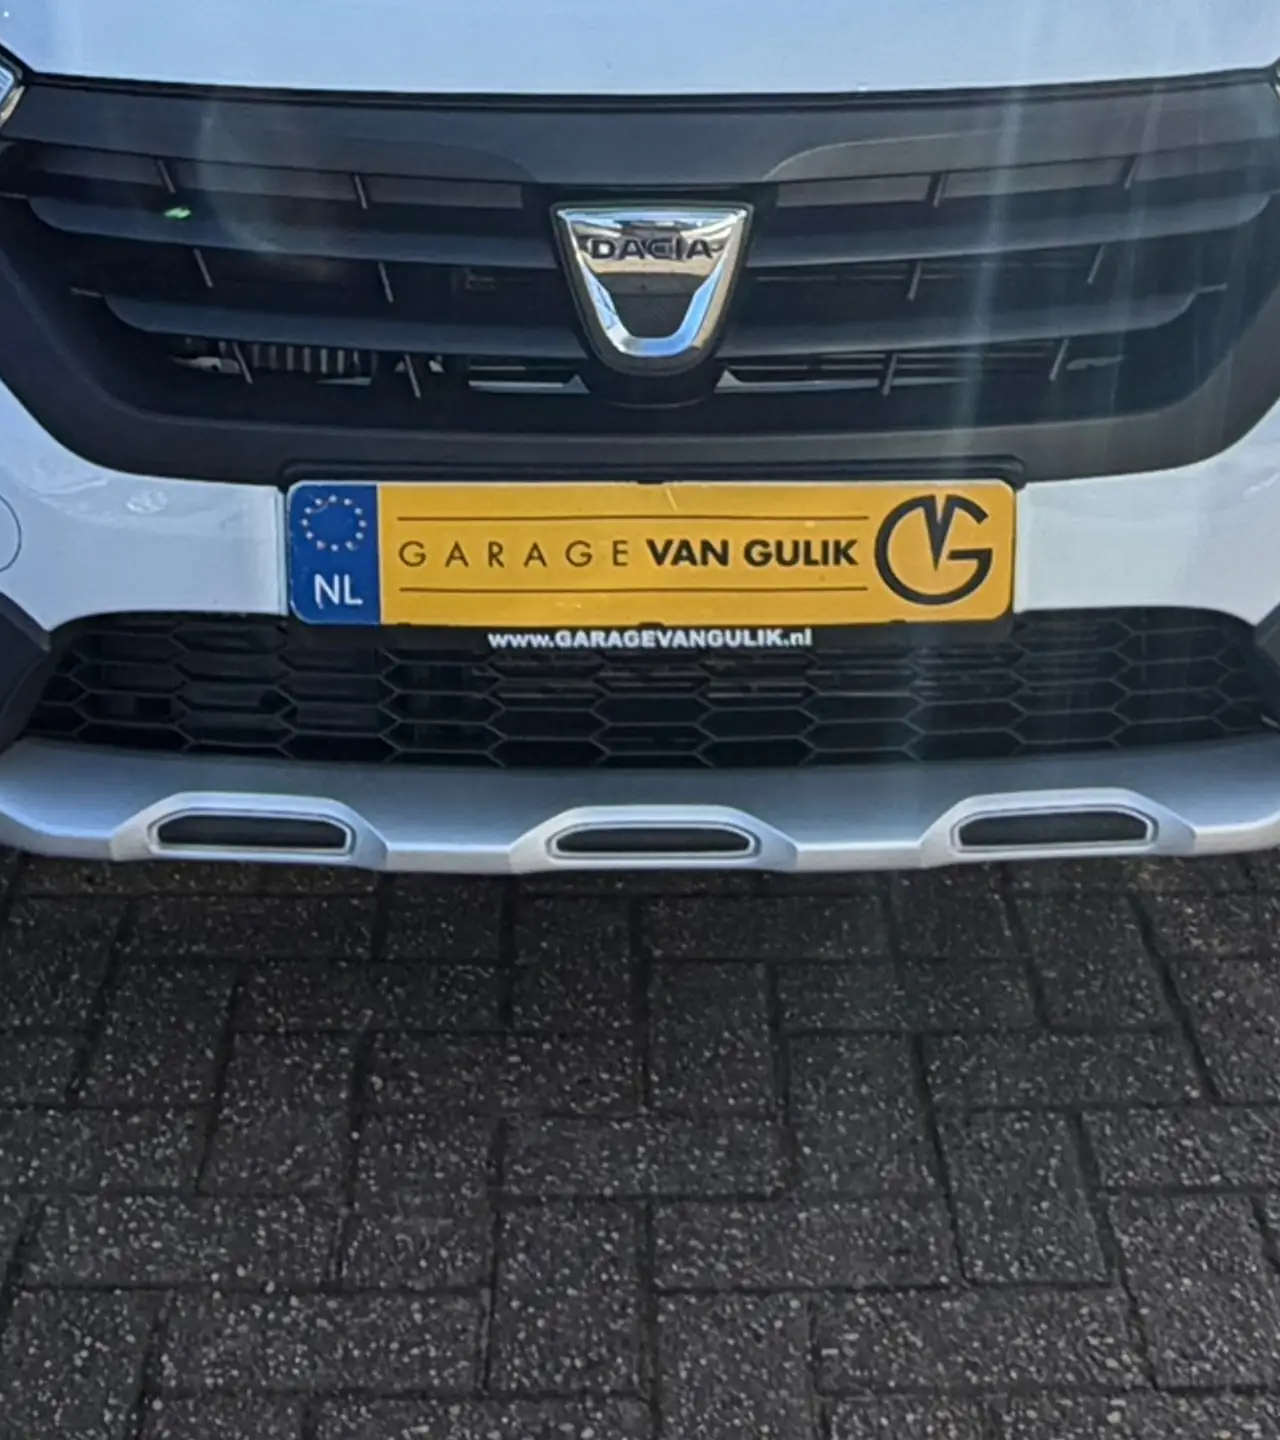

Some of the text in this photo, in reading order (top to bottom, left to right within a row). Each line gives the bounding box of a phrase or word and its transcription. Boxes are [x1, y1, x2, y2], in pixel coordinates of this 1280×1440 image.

[590, 237, 713, 261] DACIA
[398, 538, 859, 569] GARAGE VAN GULIK
[314, 573, 363, 607] NL
[487, 627, 813, 648] www.GARAGEVANGULIK.nl
